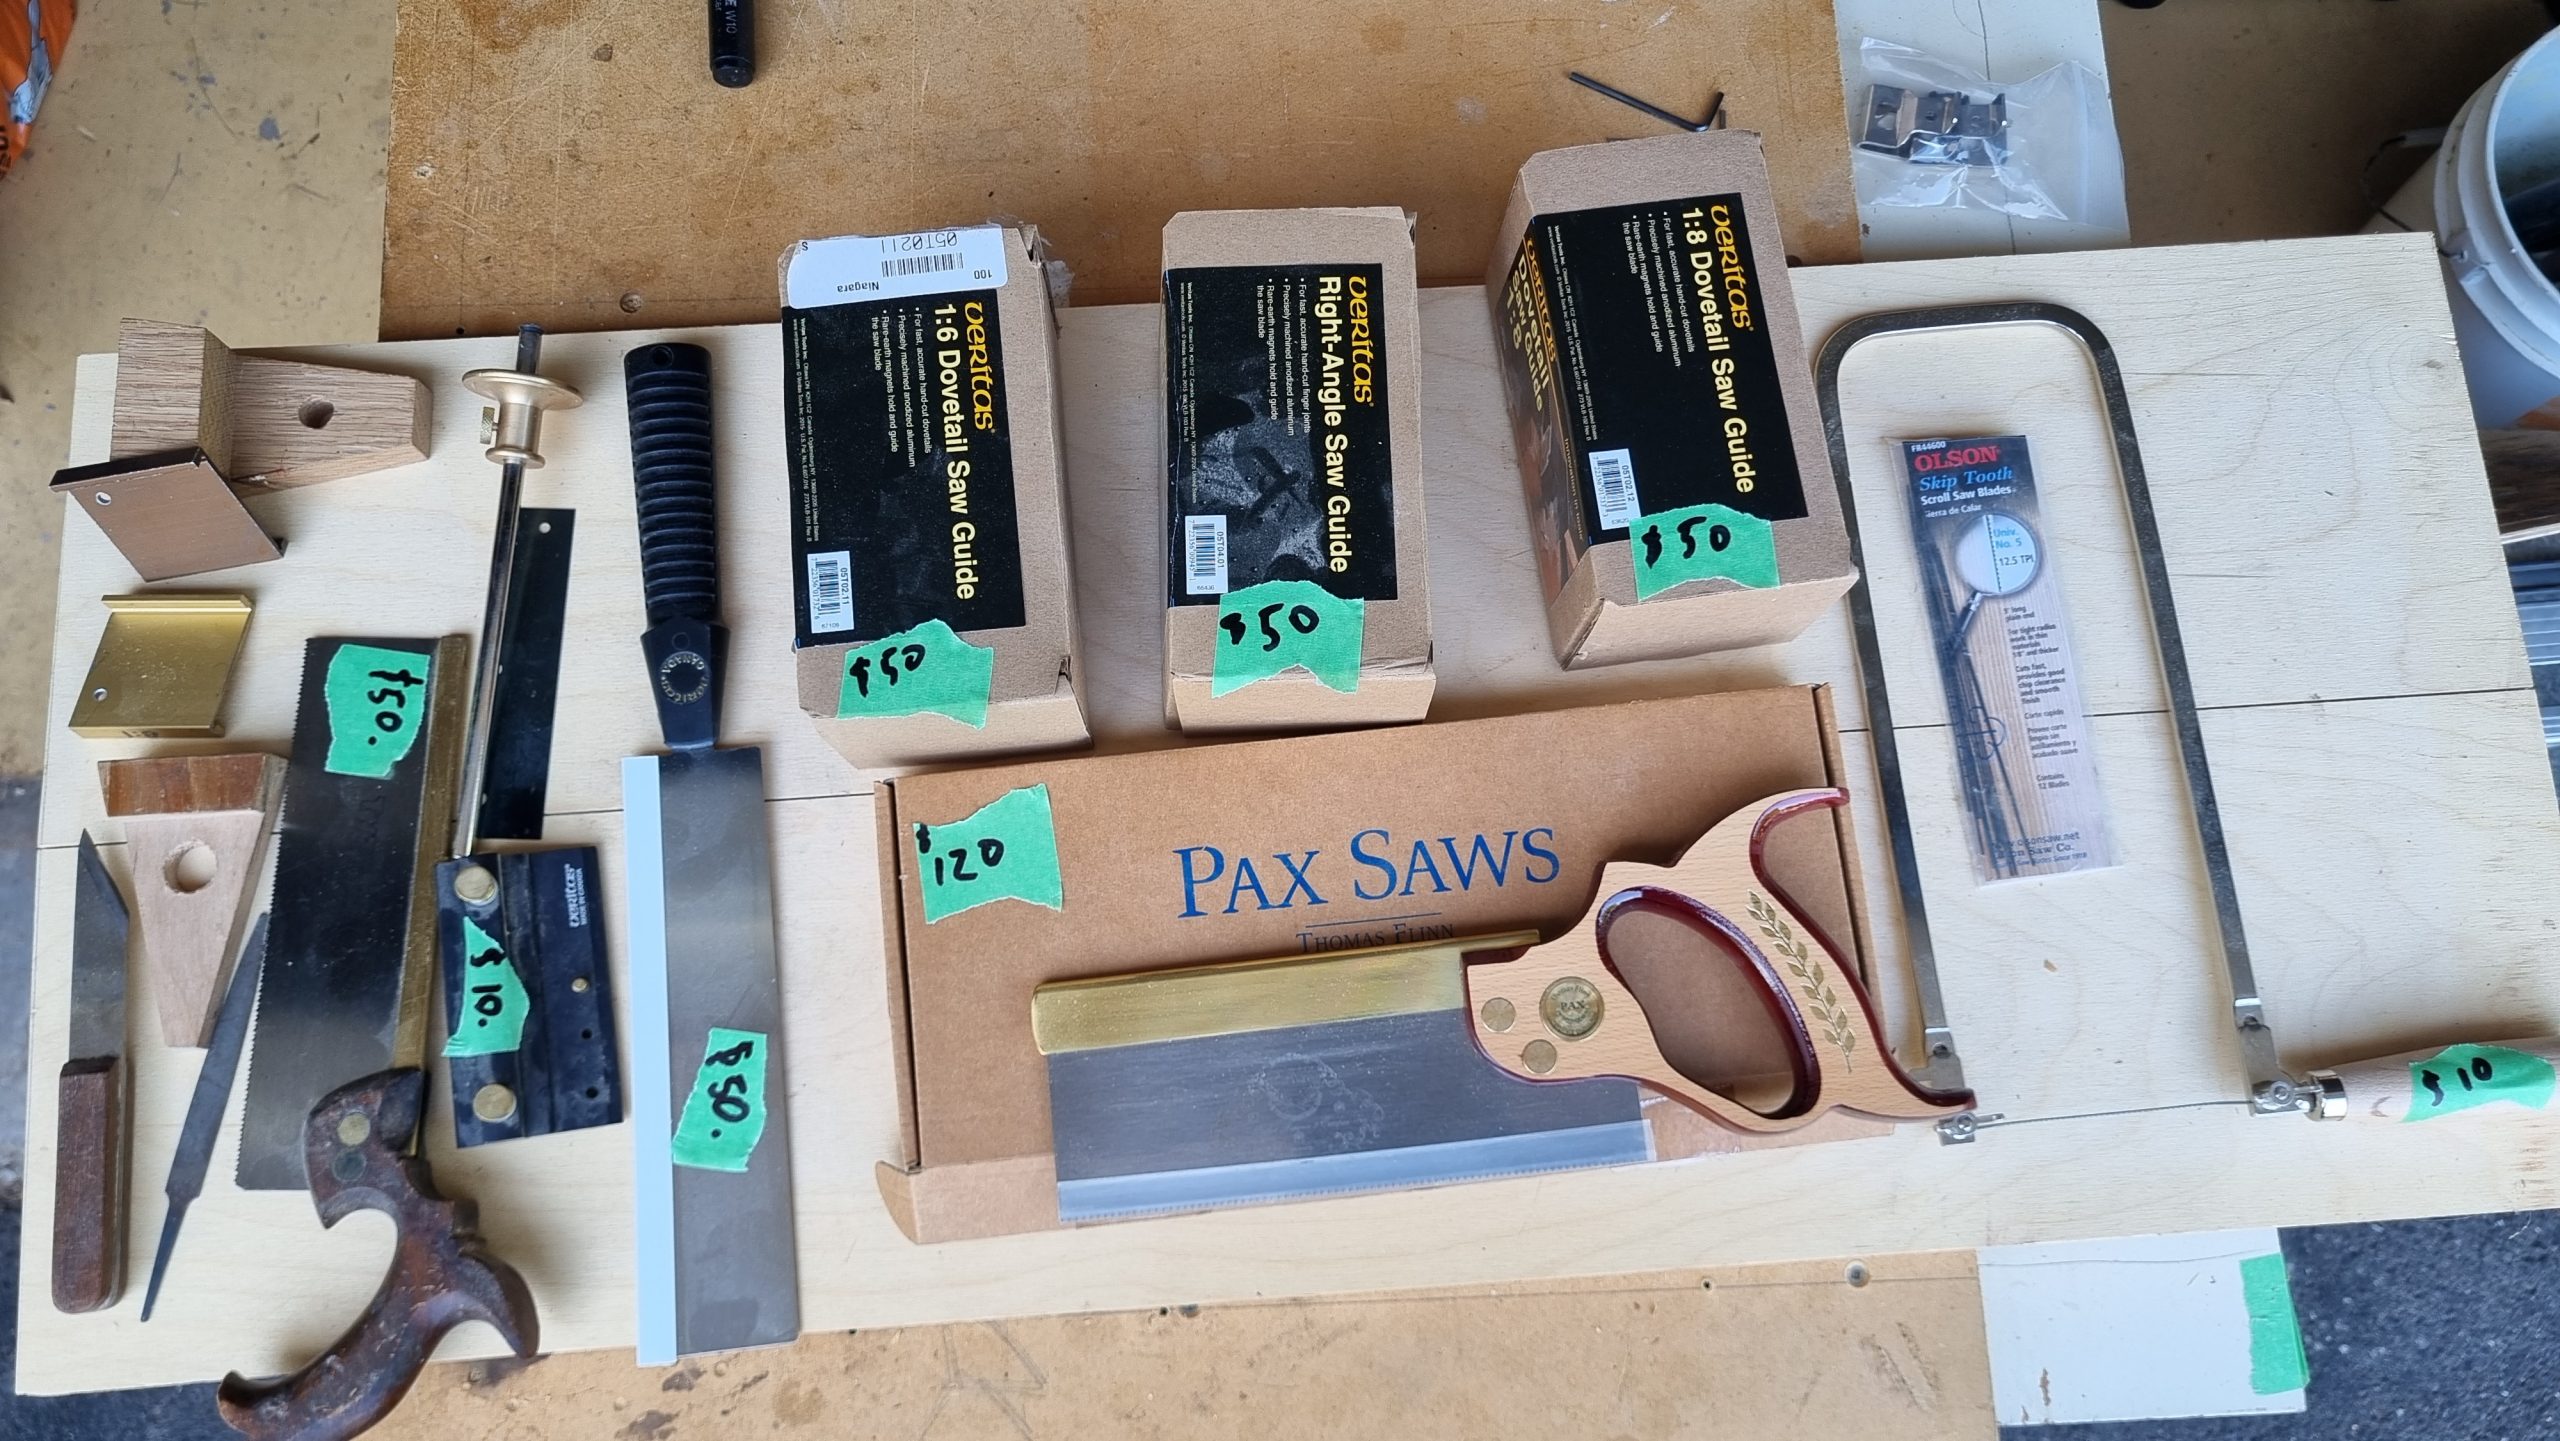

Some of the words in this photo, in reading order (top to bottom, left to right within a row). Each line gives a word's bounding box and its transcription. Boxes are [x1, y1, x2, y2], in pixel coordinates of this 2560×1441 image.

[725, 10, 738, 34] W10
[1622, 222, 1630, 235] the
[1632, 221, 1646, 262] Rare-earth
[1682, 207, 1708, 245] 1:8
[1624, 236, 1633, 252] saw
[973, 268, 993, 280] 100
[1628, 252, 1638, 274] blade
[1640, 262, 1652, 296] magnets
[837, 280, 880, 293] Niagara
[1257, 285, 1265, 298] the
[1282, 284, 1291, 320] Precisely
[1298, 284, 1307, 298] For
[1647, 219, 1660, 254] Precisely
[1654, 255, 1668, 292] machined
[1661, 293, 1675, 328] anodized
[1668, 329, 1681, 367] aluminum
[1663, 217, 1671, 231] For
[1668, 250, 1681, 283] accurate
[1675, 284, 1689, 318] hand-cut
[1682, 318, 1695, 353] dovetails
[1690, 251, 1730, 352] Dovetail
[914, 313, 923, 327] For
[1266, 285, 1276, 327] Rare-earth
[1507, 286, 1521, 350] 1:8
[1517, 253, 1549, 390] Dovetail
[1646, 296, 1657, 314] hold
[871, 316, 879, 330] the
[872, 331, 880, 347] saw
[881, 316, 892, 358] Rare-earth
[898, 315, 908, 350] Precisely
[915, 328, 924, 346] fast,
[934, 304, 959, 342] 1:6
[1257, 316, 1266, 339] blade
[1299, 317, 1308, 351] accurate
[1649, 315, 1660, 330] and
[1266, 328, 1276, 362] magnets
[1284, 321, 1293, 360] machined
[1314, 276, 1346, 427] Right-Angle
[1511, 268, 1527, 327] Saw
[1523, 331, 1543, 412] Guide
[1651, 330, 1663, 353] guide
[873, 348, 883, 371] blade
[883, 359, 894, 394] magnets
[901, 352, 911, 390] machined
[916, 347, 926, 381] accurate
[1269, 363, 1278, 380] hold
[1301, 352, 1310, 387] hand-cut
[1269, 381, 1278, 397] and
[1285, 361, 1294, 396] anodized
[1711, 357, 1738, 411] Saw
[887, 394, 897, 412] hold
[903, 391, 914, 428] anodized
[919, 382, 929, 417] hand-cut
[937, 349, 969, 453] Dovetail
[1269, 398, 1279, 420] guide
[1301, 388, 1311, 410] finger
[888, 413, 898, 429] and
[1286, 398, 1298, 436] aluminum
[1301, 412, 1311, 434] joints
[888, 430, 899, 452] guide
[906, 429, 916, 468] aluminum
[922, 418, 932, 454] dovetails
[1325, 433, 1348, 488] Saw
[1723, 417, 1756, 493] Guide
[1914, 446, 1998, 472] OLSON
[947, 460, 971, 514] Saw
[1621, 465, 1635, 502] 05T02.12
[1919, 475, 1957, 491] Skip
[1964, 466, 2013, 485] Tooth
[1920, 492, 1951, 506] Scroll
[1952, 489, 1975, 501] Saw
[1977, 485, 2012, 498] Blades
[1948, 506, 1960, 515] de
[1960, 503, 1982, 513] Calar
[1216, 531, 1225, 568] 05T04.01
[1327, 495, 1352, 573] Guide
[1641, 516, 1732, 570] $50
[1993, 528, 2018, 537] Univ.
[1995, 540, 2011, 549] No.
[2016, 538, 2022, 547] 5
[951, 520, 979, 600] Guide
[1999, 555, 2018, 567] 12.5
[2020, 554, 2034, 563] TPI
[840, 567, 850, 605] 05T02.11
[1219, 602, 1320, 652] $50
[2036, 623, 2056, 632] radius
[2039, 645, 2059, 654] thicker
[850, 643, 926, 698] $50
[2034, 677, 2065, 687] clearance
[2035, 685, 2060, 694] smooth
[2036, 773, 2065, 782] Contains
[2048, 780, 2070, 789] Blades
[915, 823, 1004, 886] $120
[2056, 842, 2074, 852] Co.
[576, 868, 585, 895] CANADA
[1172, 845, 1329, 918] PAX
[1350, 827, 1561, 900] SAWS
[1296, 928, 1386, 953] THOMAS
[1392, 922, 1454, 945] FLINN
[1560, 1000, 1585, 1010] PAX
[2422, 1056, 2493, 1107] $10
